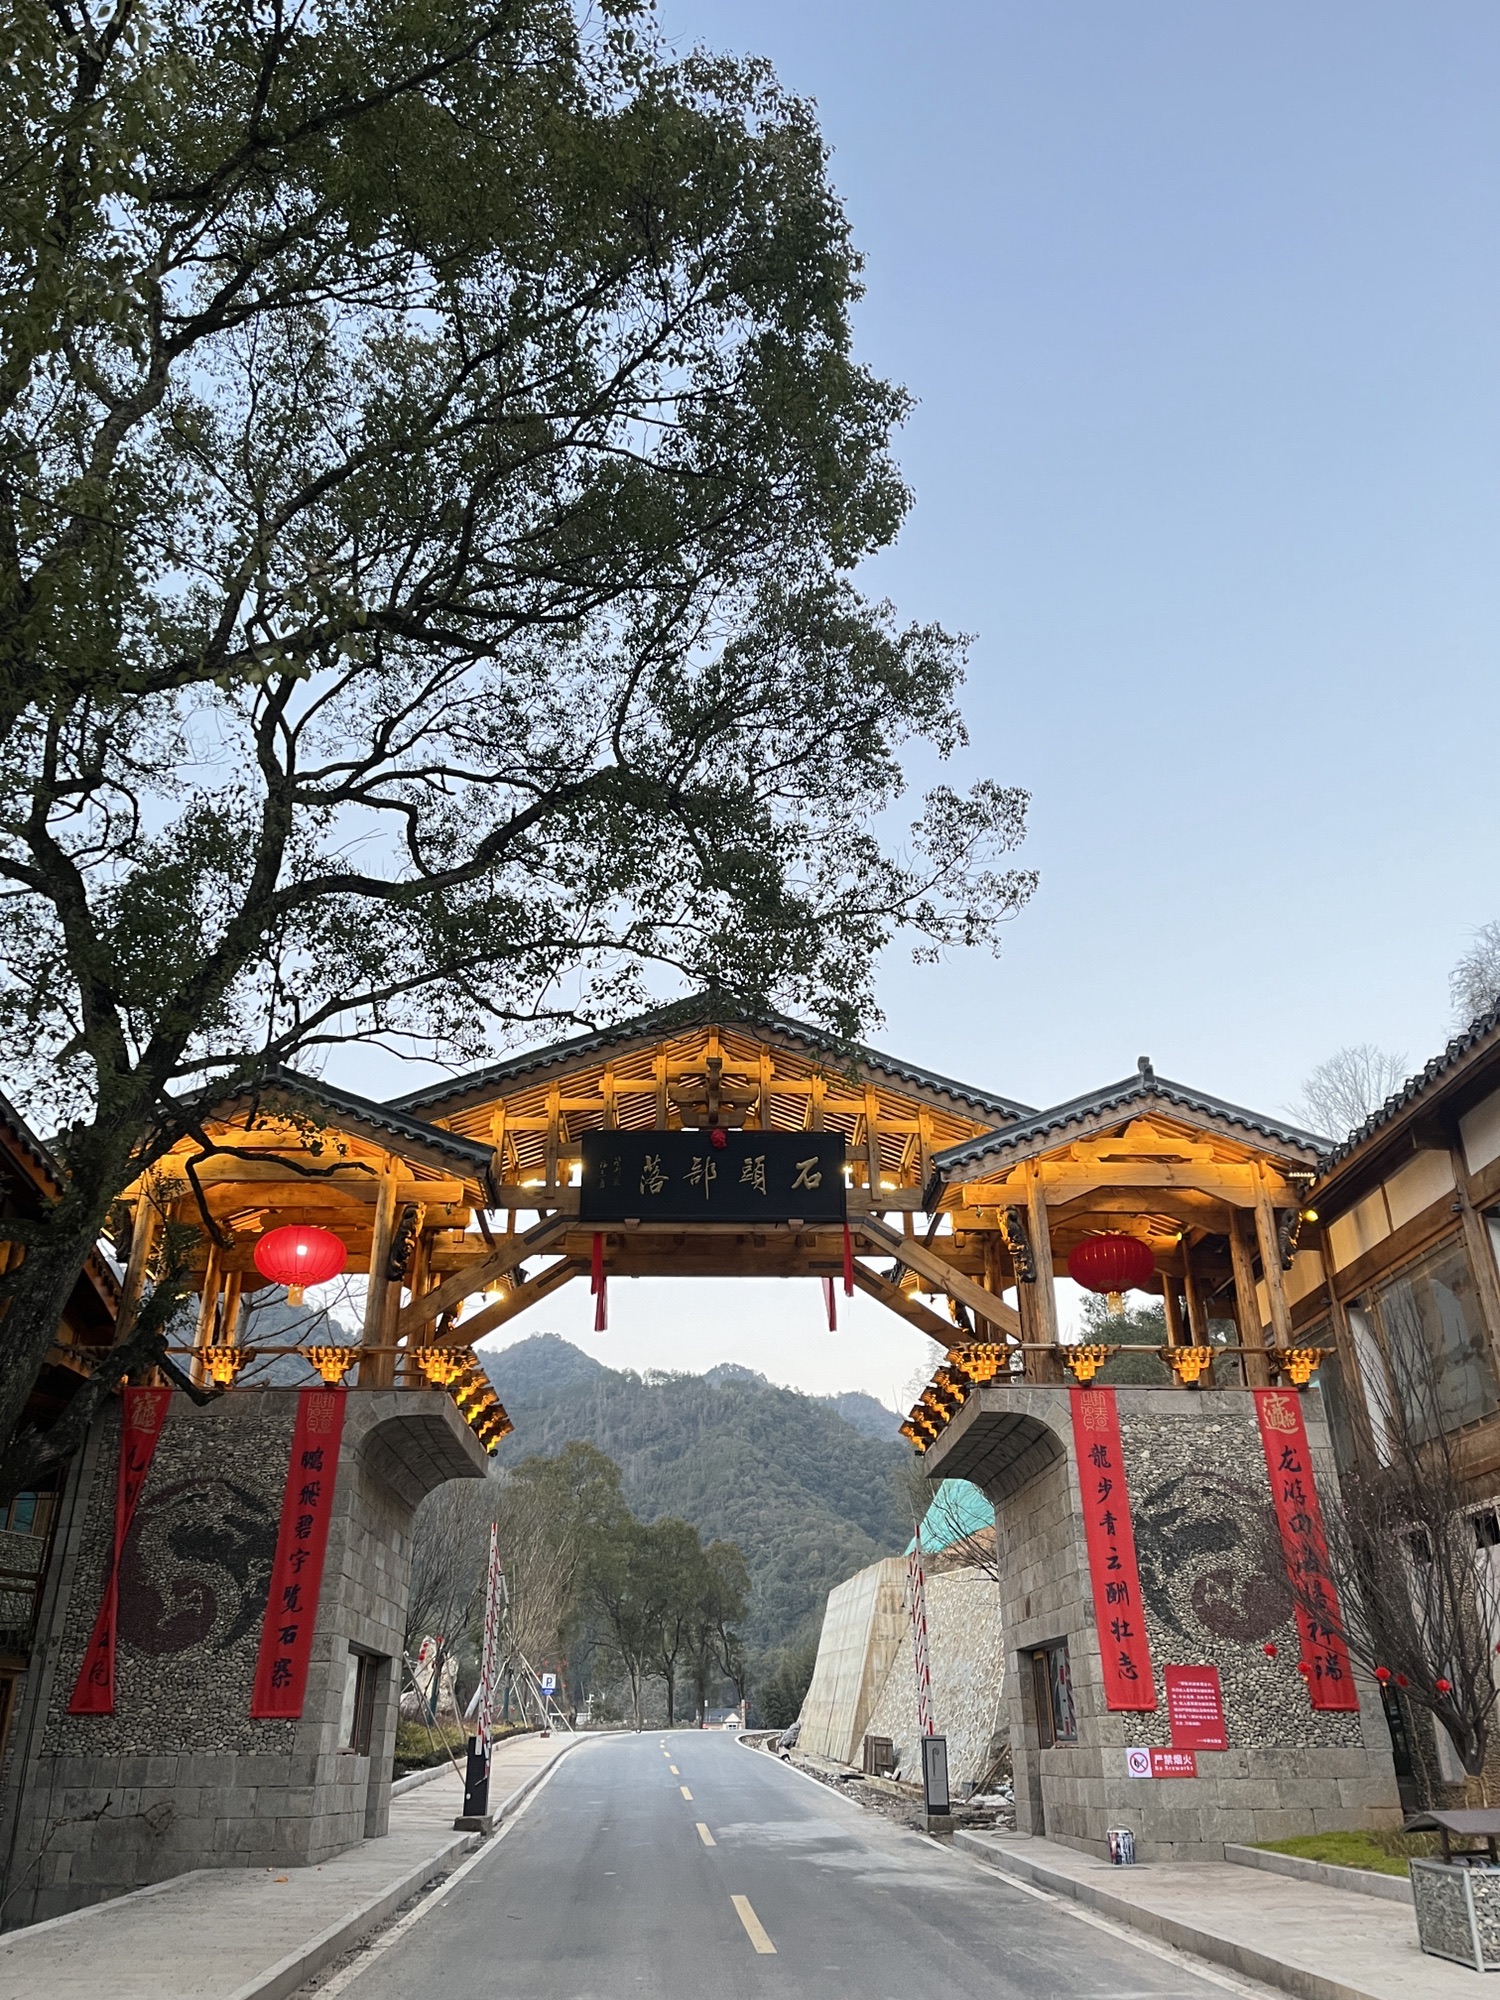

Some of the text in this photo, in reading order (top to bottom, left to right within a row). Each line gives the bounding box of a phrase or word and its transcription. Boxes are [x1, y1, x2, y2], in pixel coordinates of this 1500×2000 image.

[546, 1677, 553, 1687] P
[1154, 1754, 1193, 1766] 严禁烟火
